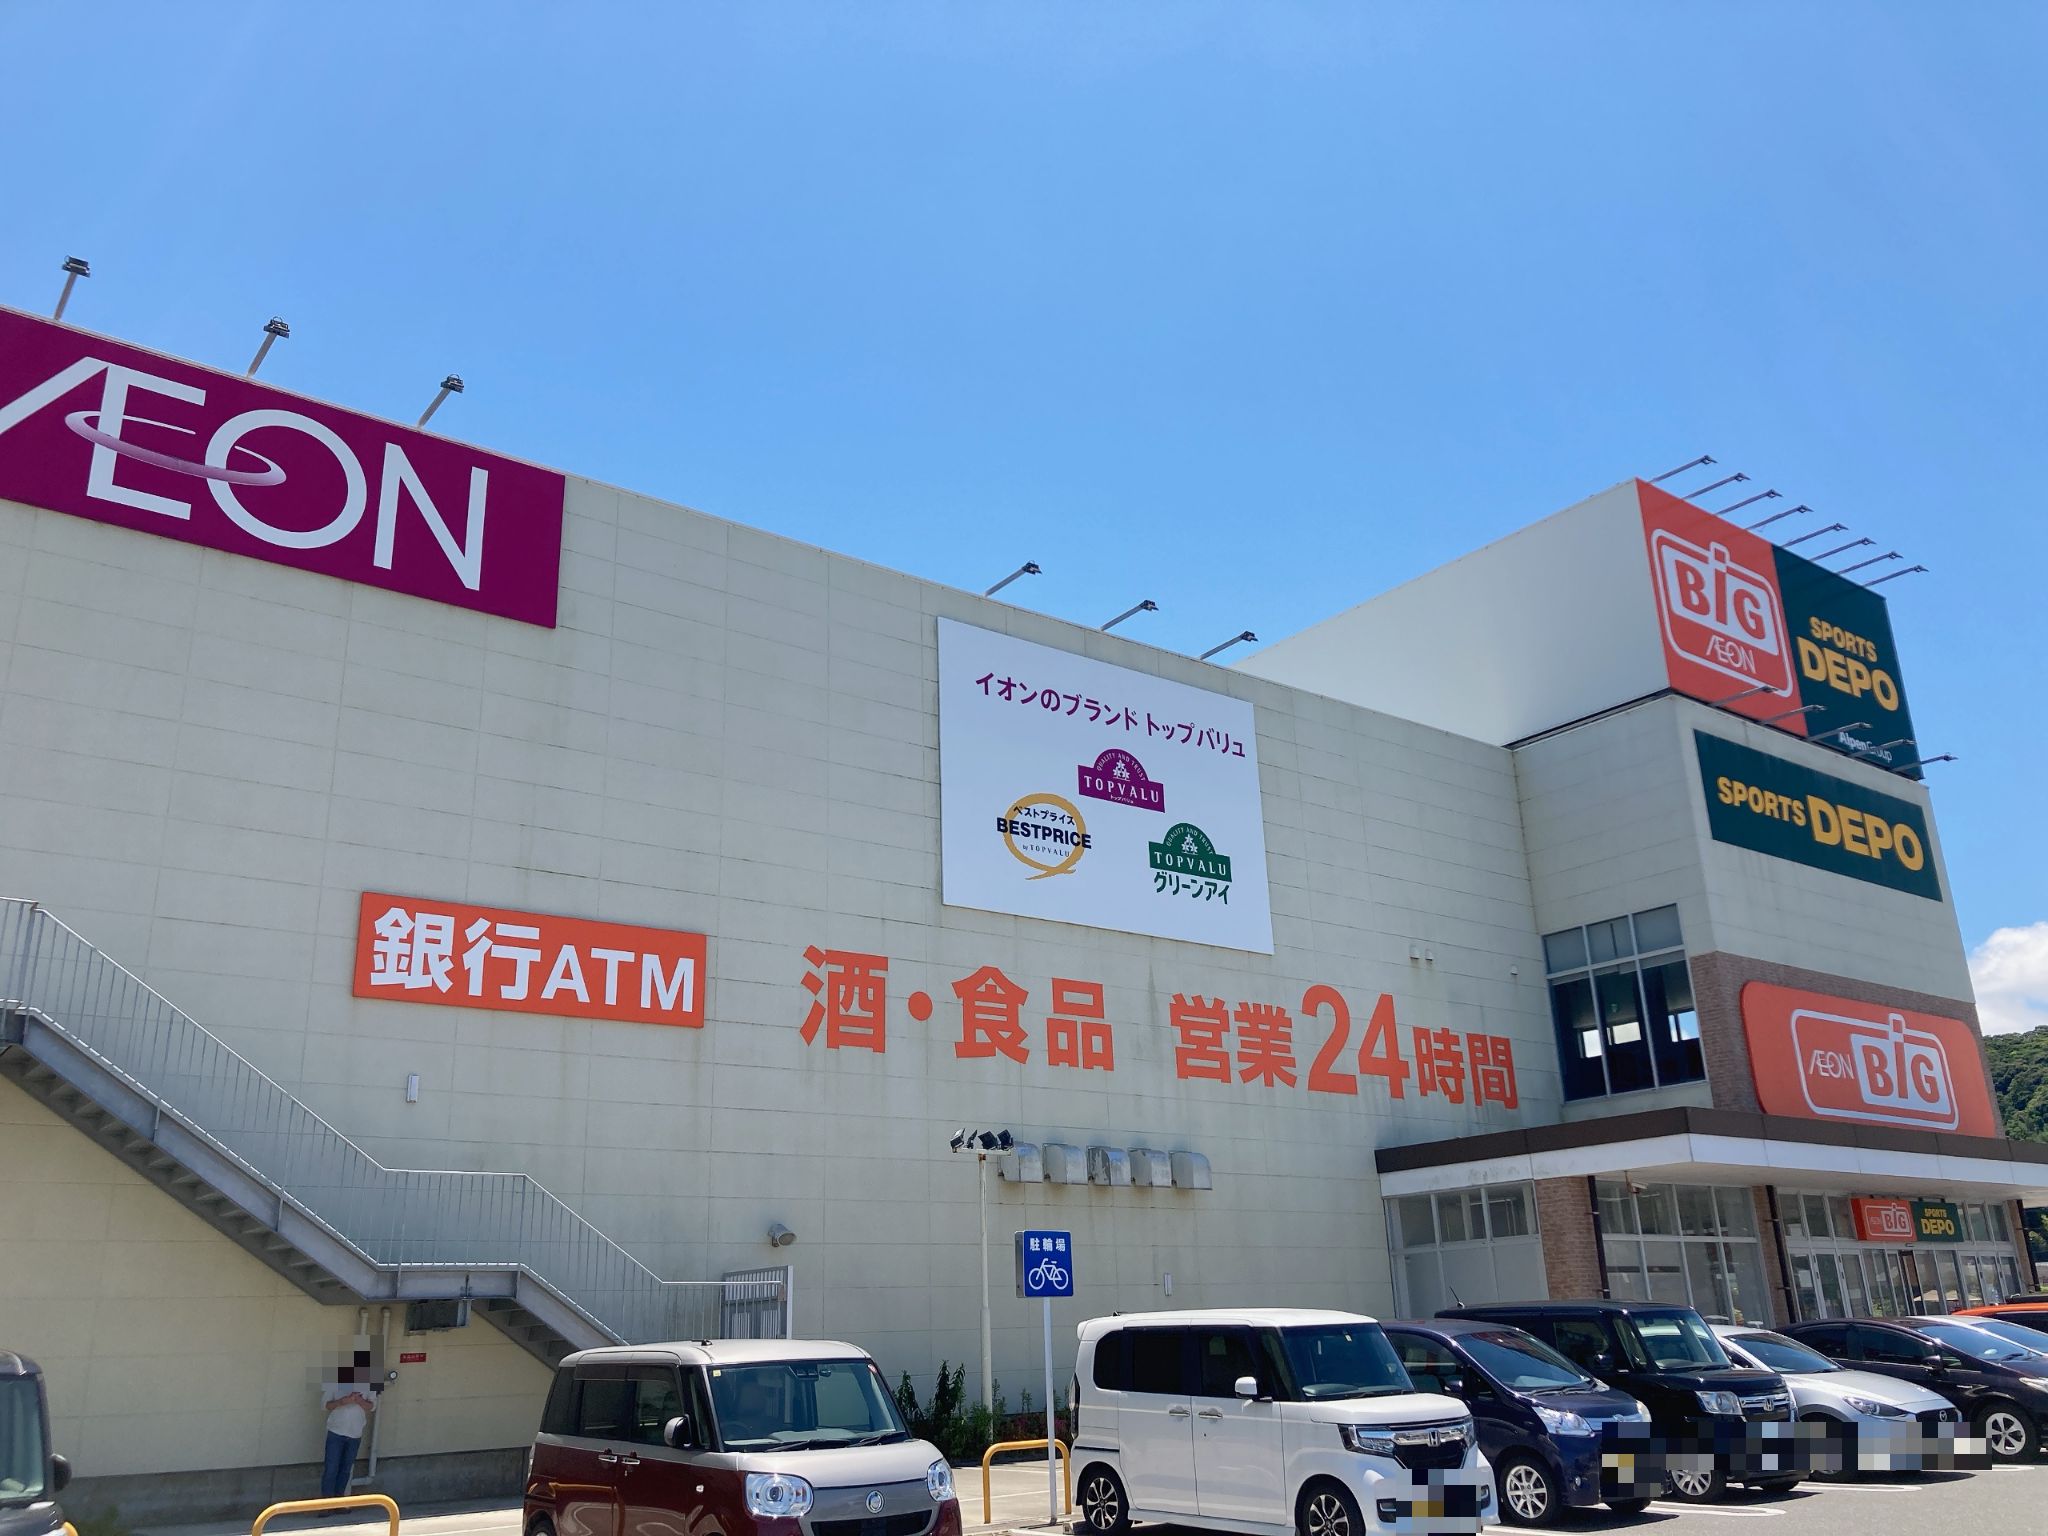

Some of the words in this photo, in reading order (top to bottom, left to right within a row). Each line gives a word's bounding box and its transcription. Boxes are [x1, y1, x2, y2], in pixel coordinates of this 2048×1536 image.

[1809, 616, 1878, 663] SPORTS
[1797, 636, 1899, 711] DEPO
[976, 672, 1138, 731] イオンのブランド
[1147, 713, 1246, 758] トップバリュ
[1097, 752, 1116, 771] QUALITY
[1118, 753, 1130, 763] AND
[1131, 760, 1146, 780] TRUST
[1083, 775, 1159, 803] TOPVALU
[1013, 806, 1075, 826] ベストプライス
[1718, 776, 1806, 827] SPORTS
[1806, 795, 1924, 871] DEPO
[996, 817, 1092, 849] BESTPRICE
[1166, 826, 1184, 847] QUALITY
[1186, 826, 1198, 837] AND
[1199, 834, 1214, 854] TRUST
[1030, 845, 1070, 857] TOPVALU
[1154, 851, 1226, 876] TOPVALU
[1154, 871, 1229, 905] グリーンアイ
[370, 907, 695, 1012] 銀行ATM
[1169, 984, 1518, 1110] 営業24時間
[1920, 1218, 1955, 1235] DEPO
[1924, 1208, 1947, 1218] SPORTS
[1030, 1237, 1066, 1252] 駐輪場
